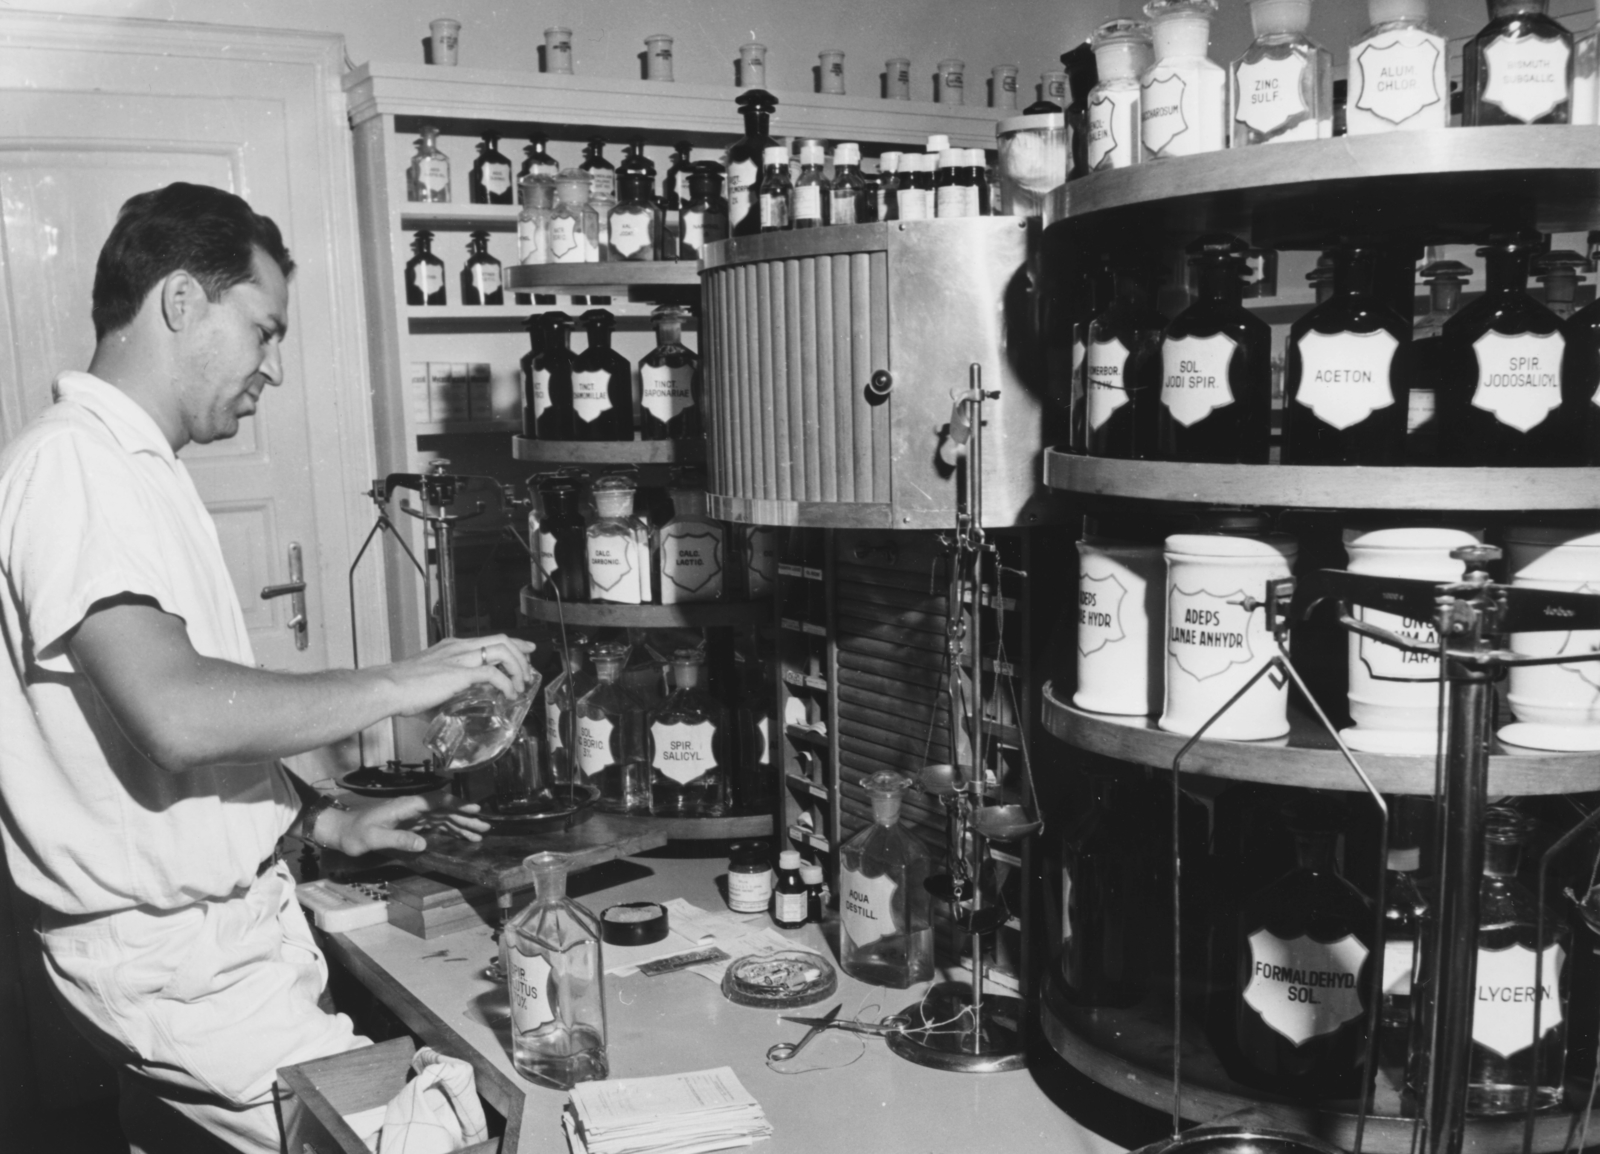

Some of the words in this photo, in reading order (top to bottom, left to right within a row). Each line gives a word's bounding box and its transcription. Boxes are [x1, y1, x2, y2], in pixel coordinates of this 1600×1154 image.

[1251, 91, 1282, 104] SULF.
[1179, 360, 1202, 373] SOL.
[1508, 357, 1542, 371] SPIR.
[1165, 376, 1185, 388] JODI
[1188, 376, 1219, 389] SPIR.
[1315, 369, 1376, 384] ACETON.
[654, 380, 678, 389] TINCT.
[675, 558, 705, 566] LACTIC.
[1088, 610, 1112, 628] HYDR
[1184, 608, 1220, 626] ADEPS
[1171, 626, 1197, 645] LANAE
[1199, 631, 1243, 649] ANHYDR
[670, 741, 694, 751] SPIR.
[663, 751, 704, 761] SALICYL.
[849, 889, 870, 904] AQUA
[845, 902, 879, 920] DESTILL.
[1255, 961, 1357, 989] FORMALDEHYD.
[1287, 985, 1321, 1004] SOL.
[1478, 985, 1554, 1003] LYCERN.
